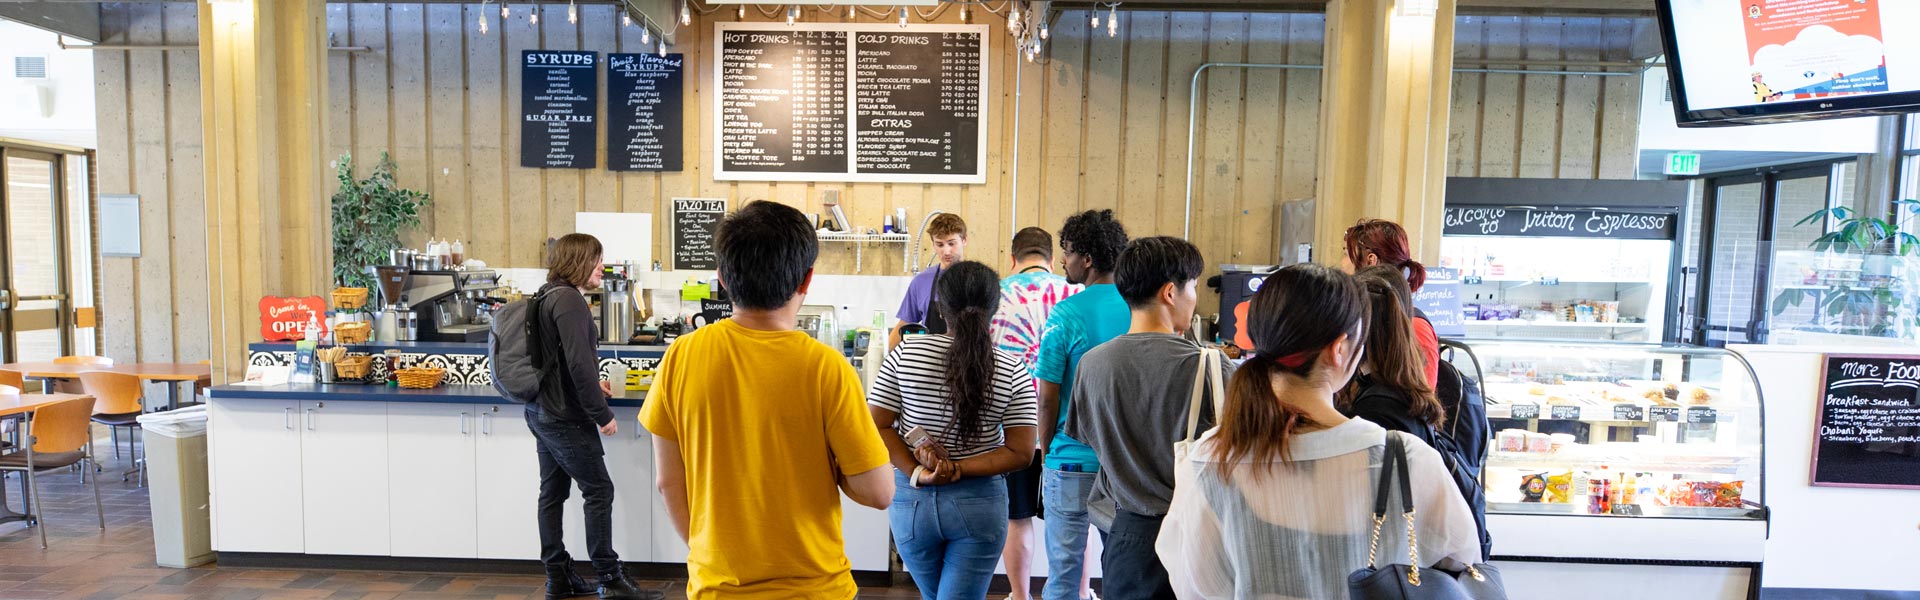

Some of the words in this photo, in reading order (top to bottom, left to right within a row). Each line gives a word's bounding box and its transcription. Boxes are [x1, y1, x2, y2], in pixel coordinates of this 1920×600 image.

[725, 33, 747, 43] HOT
[750, 34, 789, 44] DRINKS
[858, 35, 887, 44] COLD
[891, 36, 929, 45] DRINKS
[527, 54, 592, 64] SYRUPS
[871, 119, 912, 128] EXTRAS
[1672, 154, 1696, 172] EXIT
[676, 201, 702, 210] TAZO
[704, 201, 723, 210] TEA
[1443, 209, 1505, 229] elcome
[1585, 211, 1668, 234] Espresso
[269, 304, 295, 318] Come
[272, 321, 312, 333] OPE
[1841, 362, 1881, 378] More
[1826, 394, 1869, 407] Breakfast
[1821, 426, 1854, 436] Chobani
